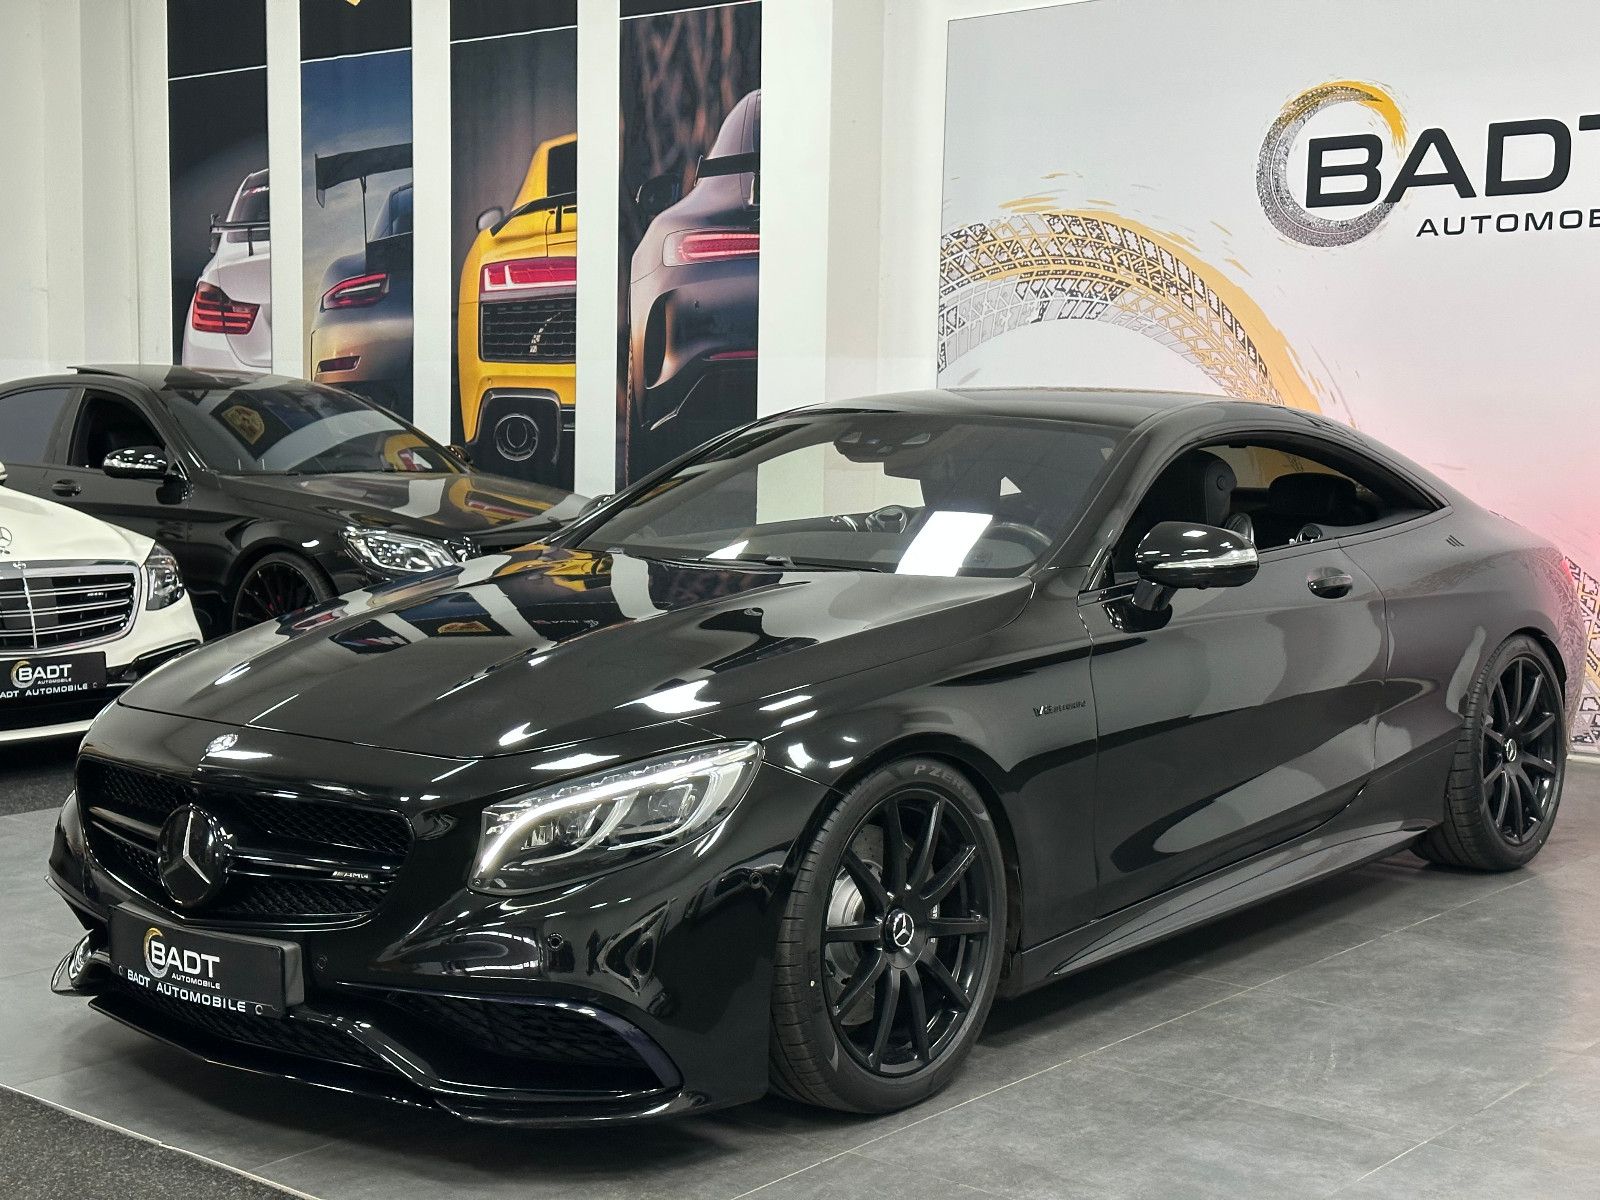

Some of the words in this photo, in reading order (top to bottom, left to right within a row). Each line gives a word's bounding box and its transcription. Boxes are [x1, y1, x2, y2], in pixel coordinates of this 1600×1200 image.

[1306, 114, 1600, 208] BAD
[18, 663, 72, 681] BADT
[25, 683, 88, 696] AUTOMOBILE
[913, 764, 927, 775] P
[151, 940, 220, 978] BADT
[171, 973, 221, 990] AUTOMOBILE
[127, 969, 150, 988] BADT
[156, 982, 246, 1013] AUTOMOBILE
